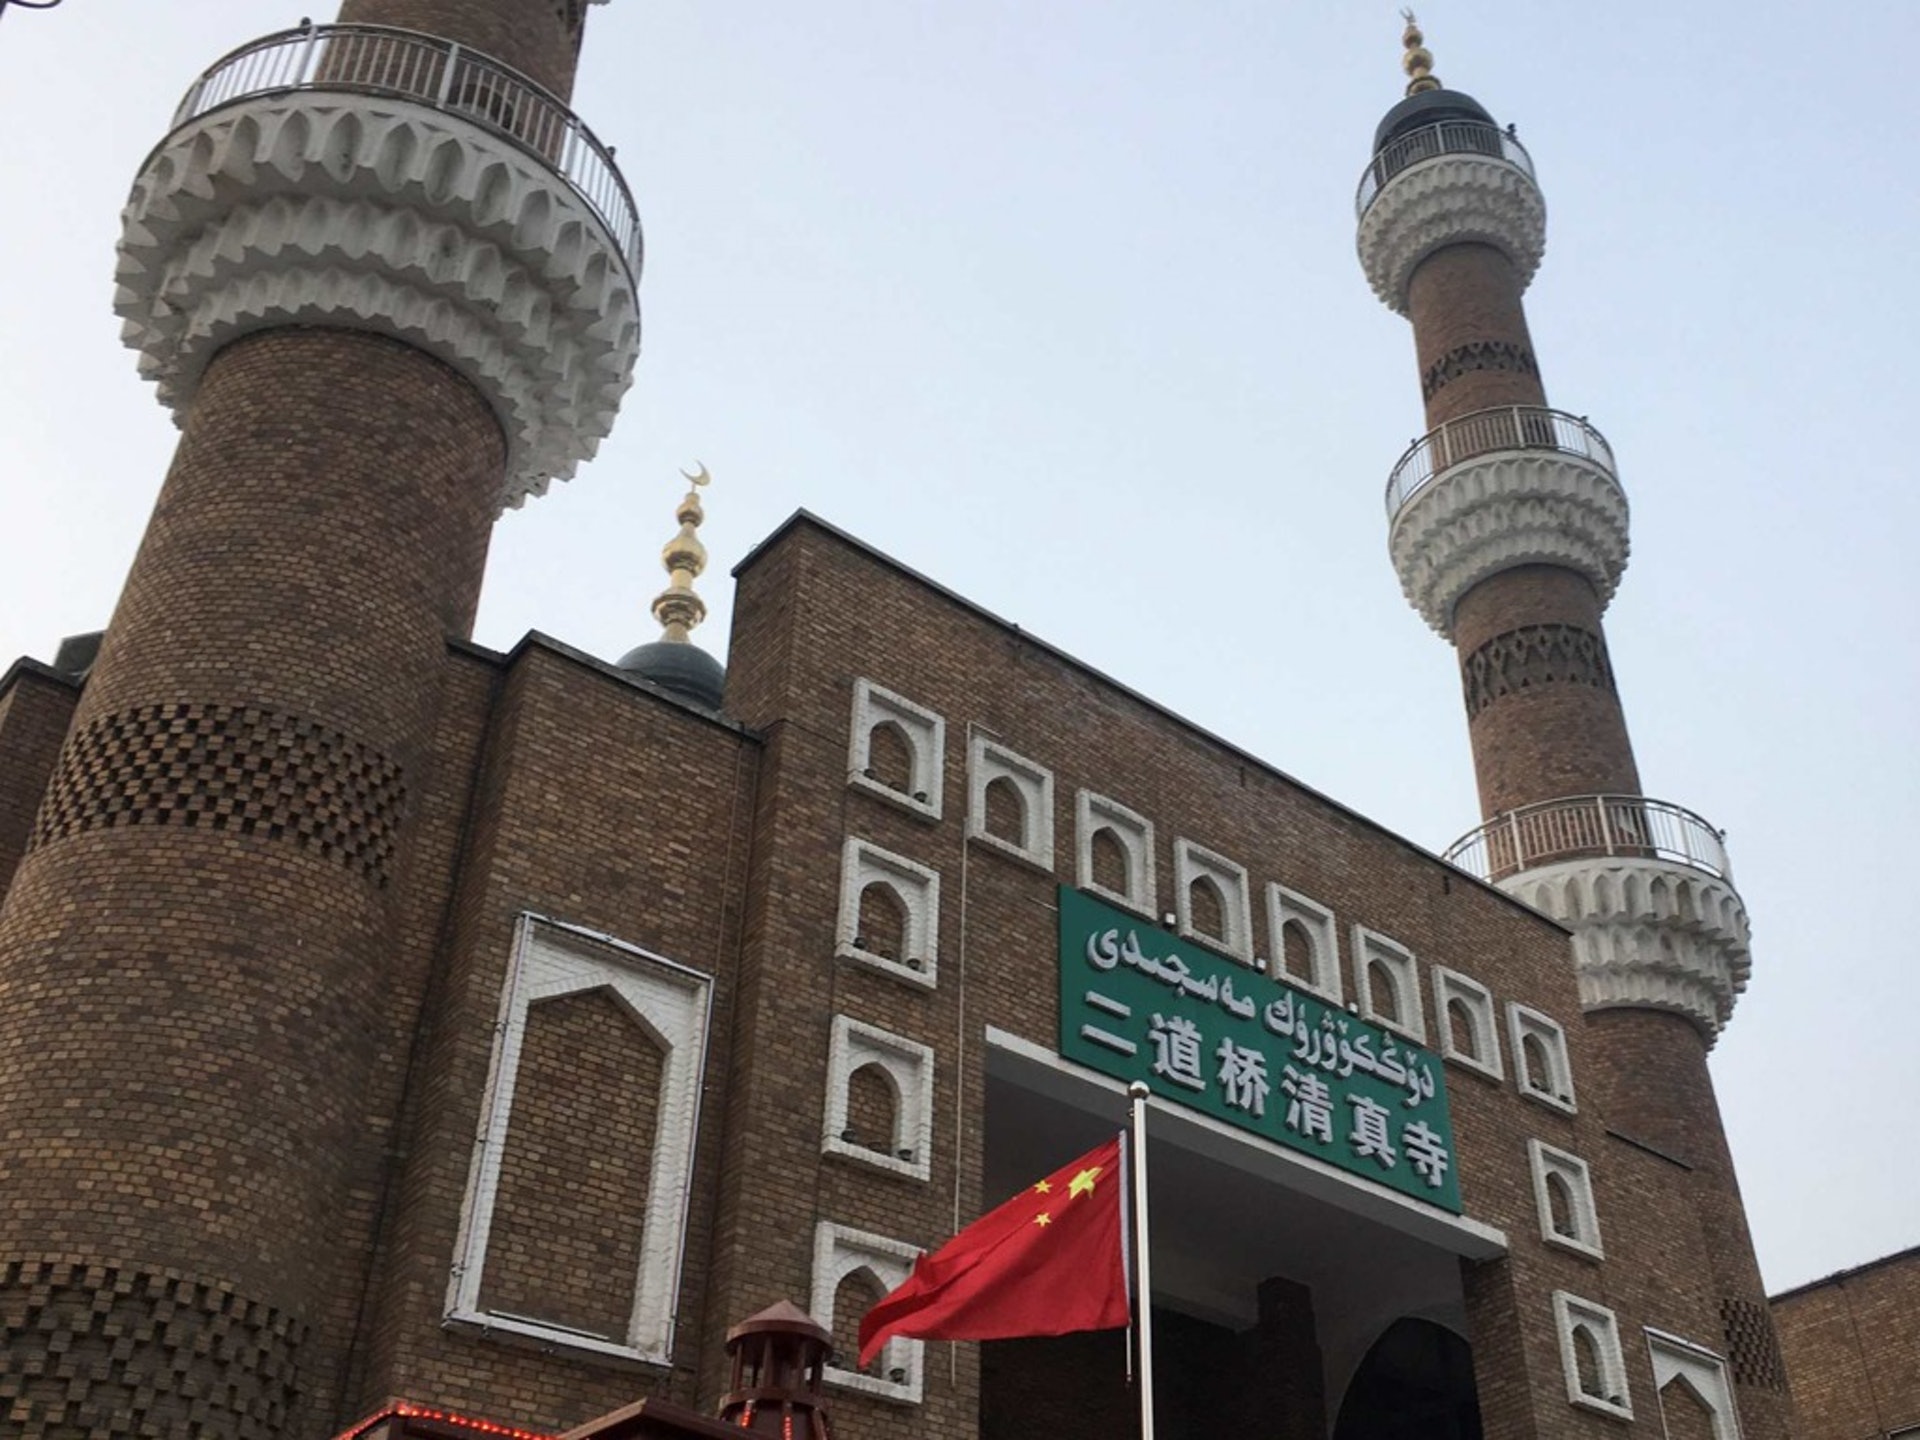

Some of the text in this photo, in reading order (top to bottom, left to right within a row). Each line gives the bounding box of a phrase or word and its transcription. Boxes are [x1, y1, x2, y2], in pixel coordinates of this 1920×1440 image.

[1081, 989, 1449, 1188] 二道桥清真寺
